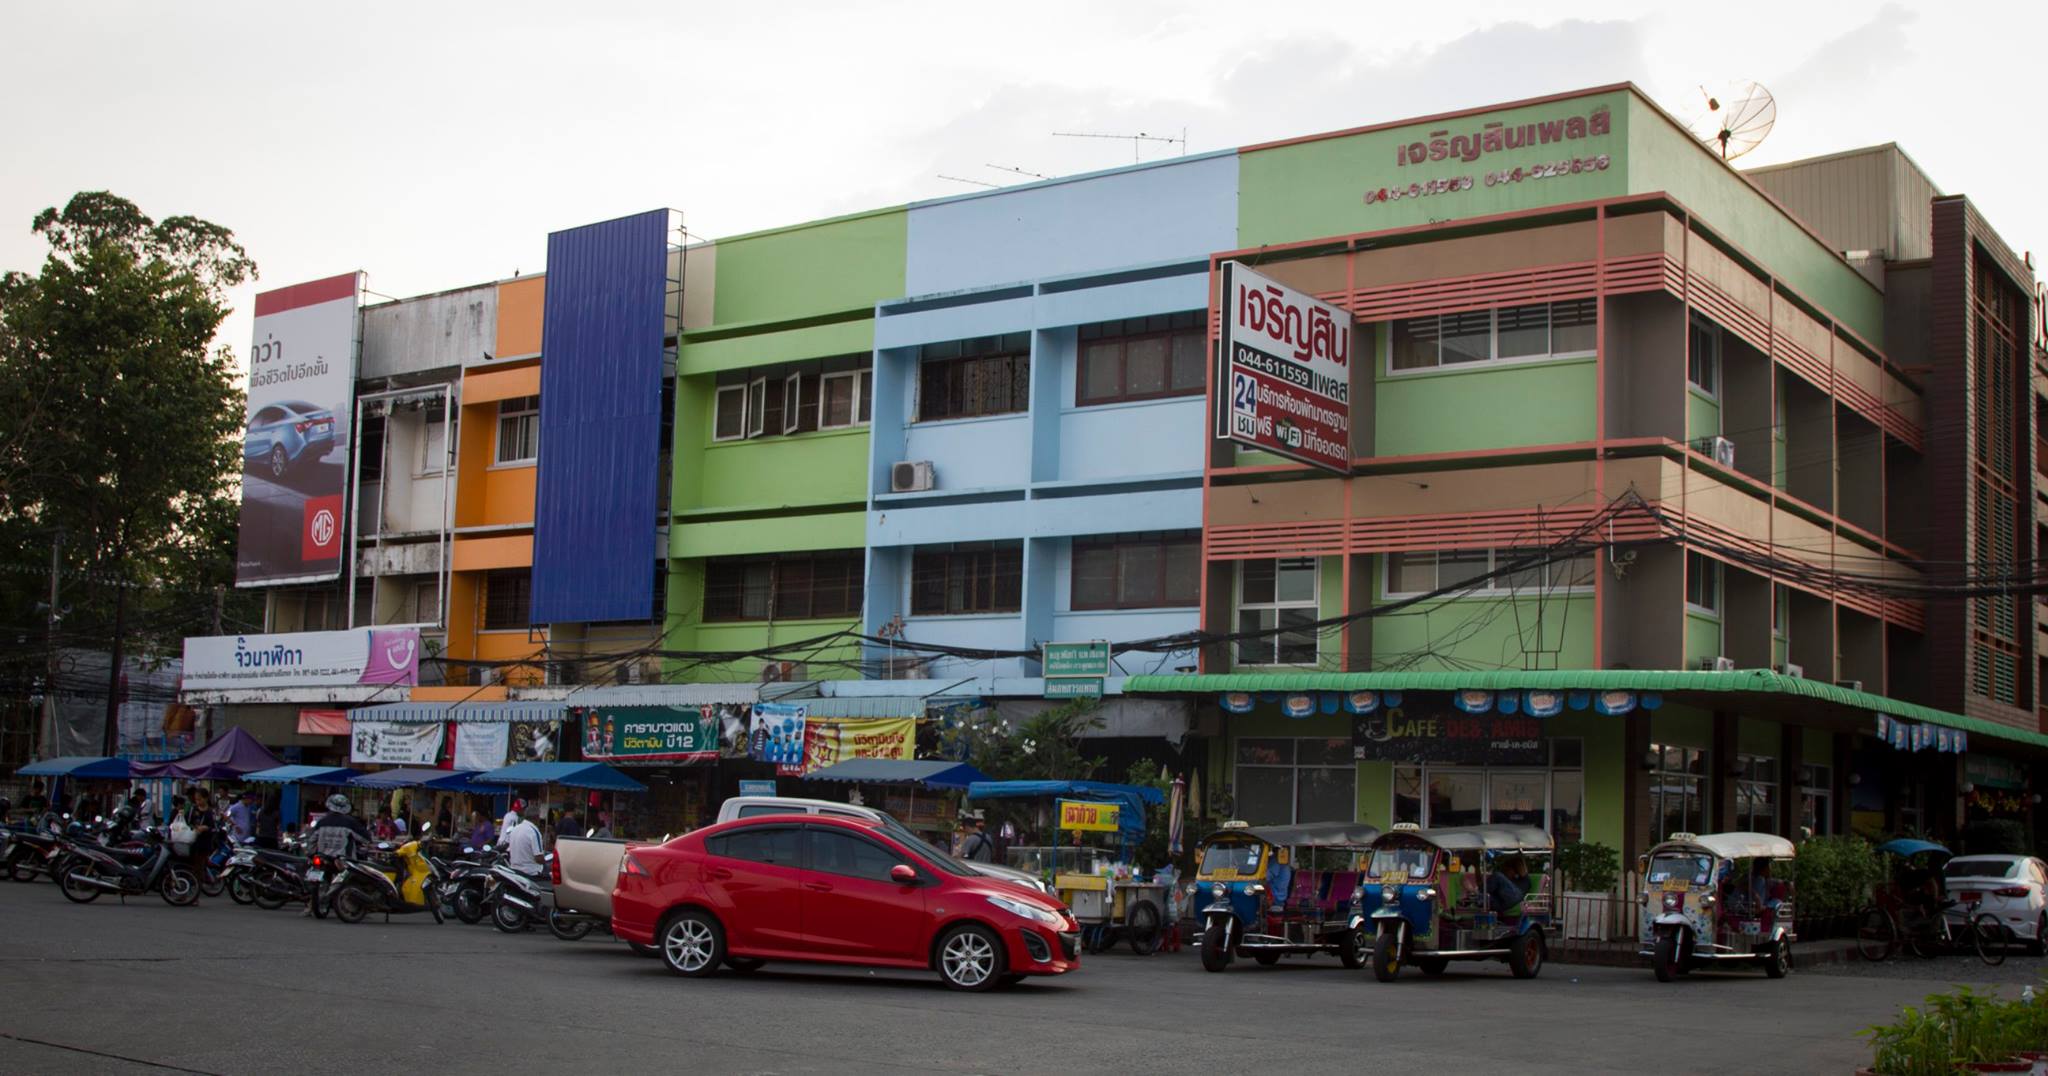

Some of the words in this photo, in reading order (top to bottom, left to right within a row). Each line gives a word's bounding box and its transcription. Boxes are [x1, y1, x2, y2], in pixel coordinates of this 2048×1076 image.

[1239, 284, 1348, 367] เจริญสิน
[1238, 349, 1309, 386] 044-611559
[1234, 374, 1257, 413] 24
[1257, 416, 1272, 437] ฟรี
[313, 511, 334, 544] MG
[624, 722, 695, 734] คาราบาวแดง
